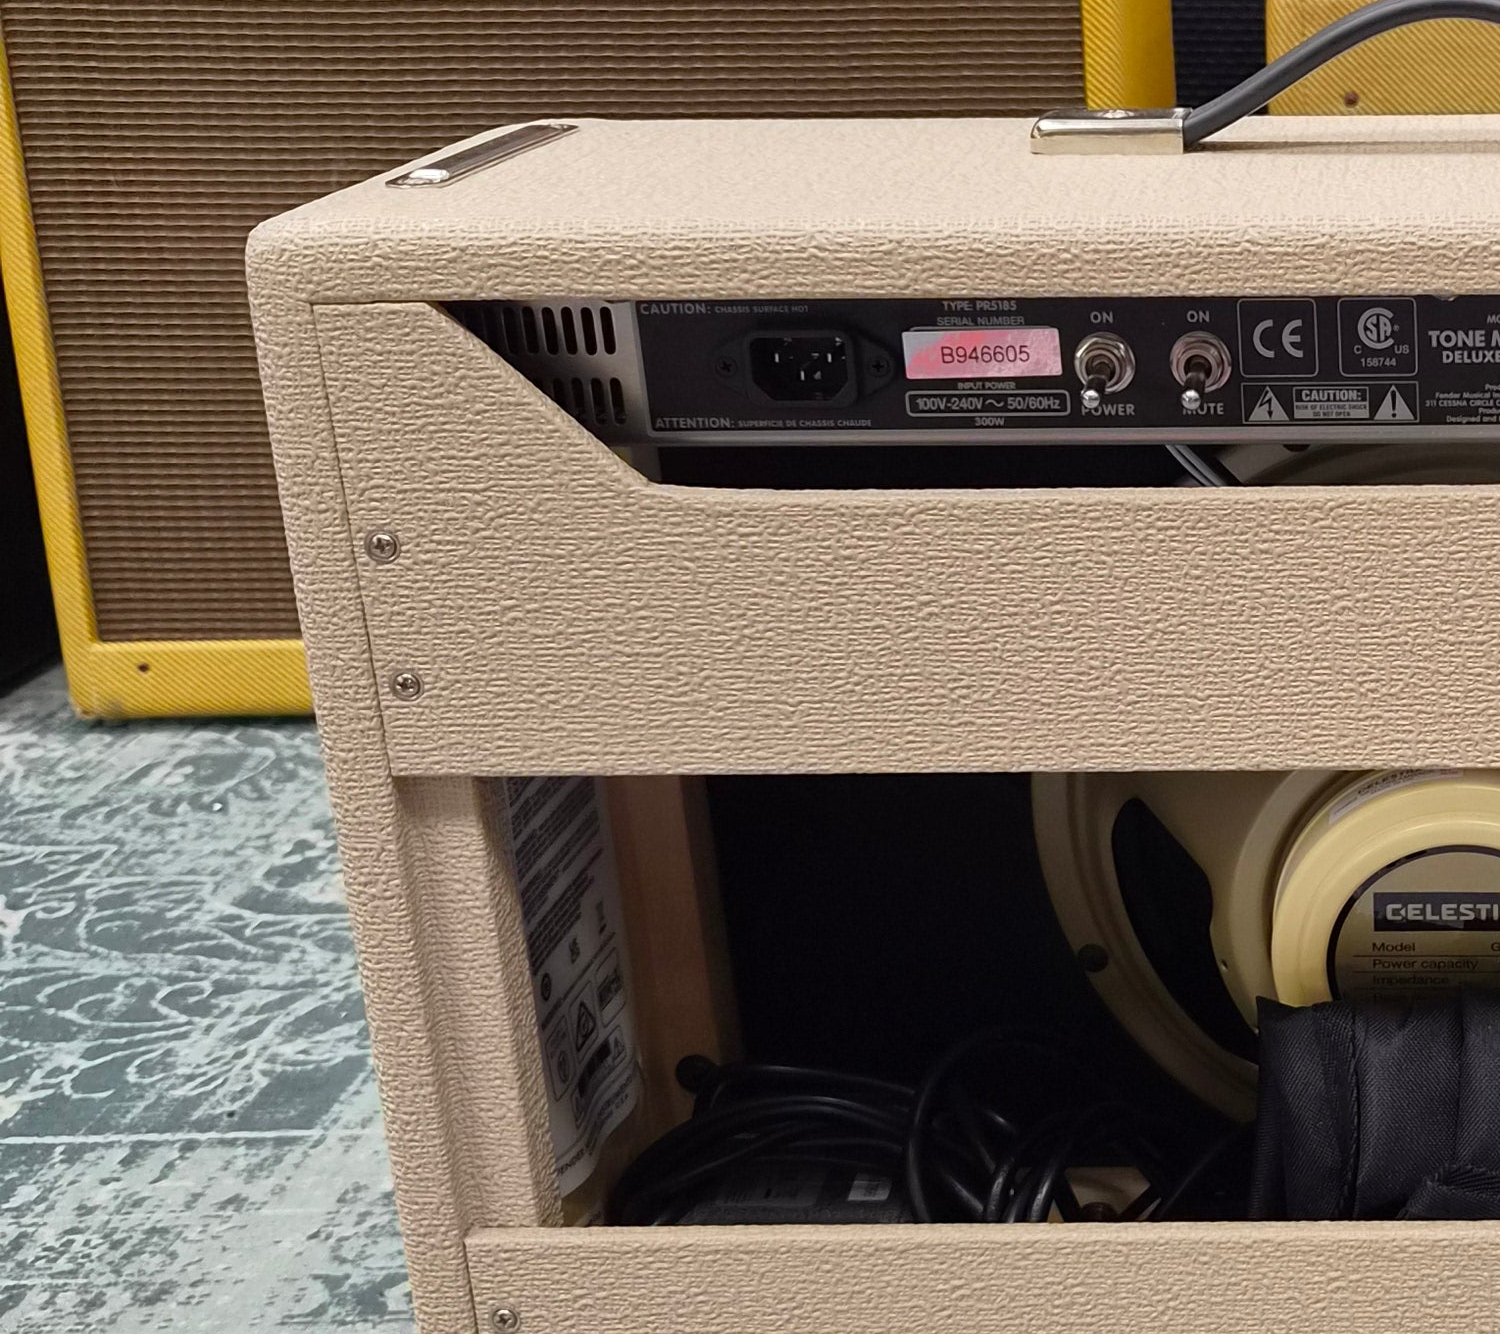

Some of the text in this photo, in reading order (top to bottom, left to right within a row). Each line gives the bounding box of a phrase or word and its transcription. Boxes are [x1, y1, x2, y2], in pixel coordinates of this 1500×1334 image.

[640, 303, 711, 316] CAUTION:
[937, 316, 1026, 326] SERIAL NUMBER
[1090, 312, 1114, 324] ON
[1187, 311, 1210, 323] ON
[1252, 319, 1304, 358] CE
[1428, 330, 1486, 347] TONE
[940, 345, 1031, 364] B946605
[1394, 345, 1410, 355] US
[1360, 357, 1397, 367] 158744
[957, 381, 1017, 390] INPUT POWER
[1301, 389, 1362, 402] CAUTION:
[1007, 397, 1061, 410] 50/60Hz
[1082, 403, 1135, 416] POWER
[655, 417, 735, 429] ATTENTION:
[975, 417, 1005, 427] 300W
[1446, 415, 1481, 424] Designed
[1482, 415, 1497, 423] and
[1372, 941, 1416, 953] Model
[1372, 958, 1418, 969] Power
[1420, 958, 1479, 972] capacity
